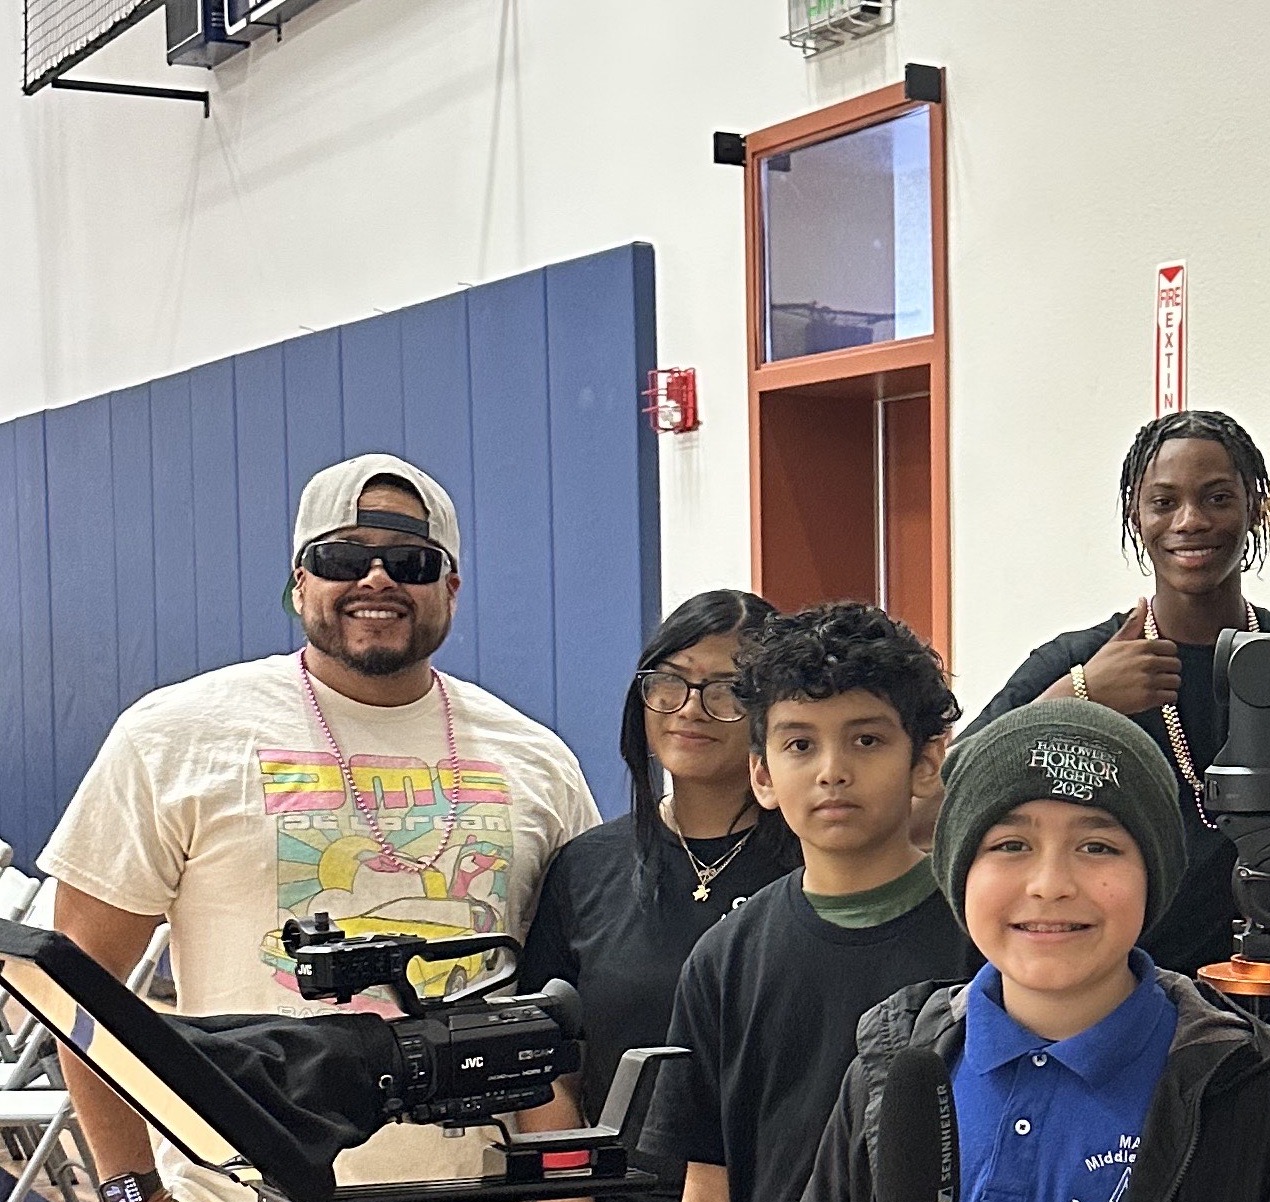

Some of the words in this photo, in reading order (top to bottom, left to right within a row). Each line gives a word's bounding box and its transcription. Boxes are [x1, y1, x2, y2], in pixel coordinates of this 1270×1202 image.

[1159, 286, 1181, 307] FIRE
[1037, 741, 1117, 763] HALLOWEEN
[1028, 749, 1120, 788] HORROR
[1046, 765, 1103, 788] NIGHTS
[1052, 779, 1093, 801] 2025
[461, 1056, 483, 1070] JVC
[936, 1083, 952, 1182] SENNHEISER
[1084, 1149, 1137, 1172] Middle
